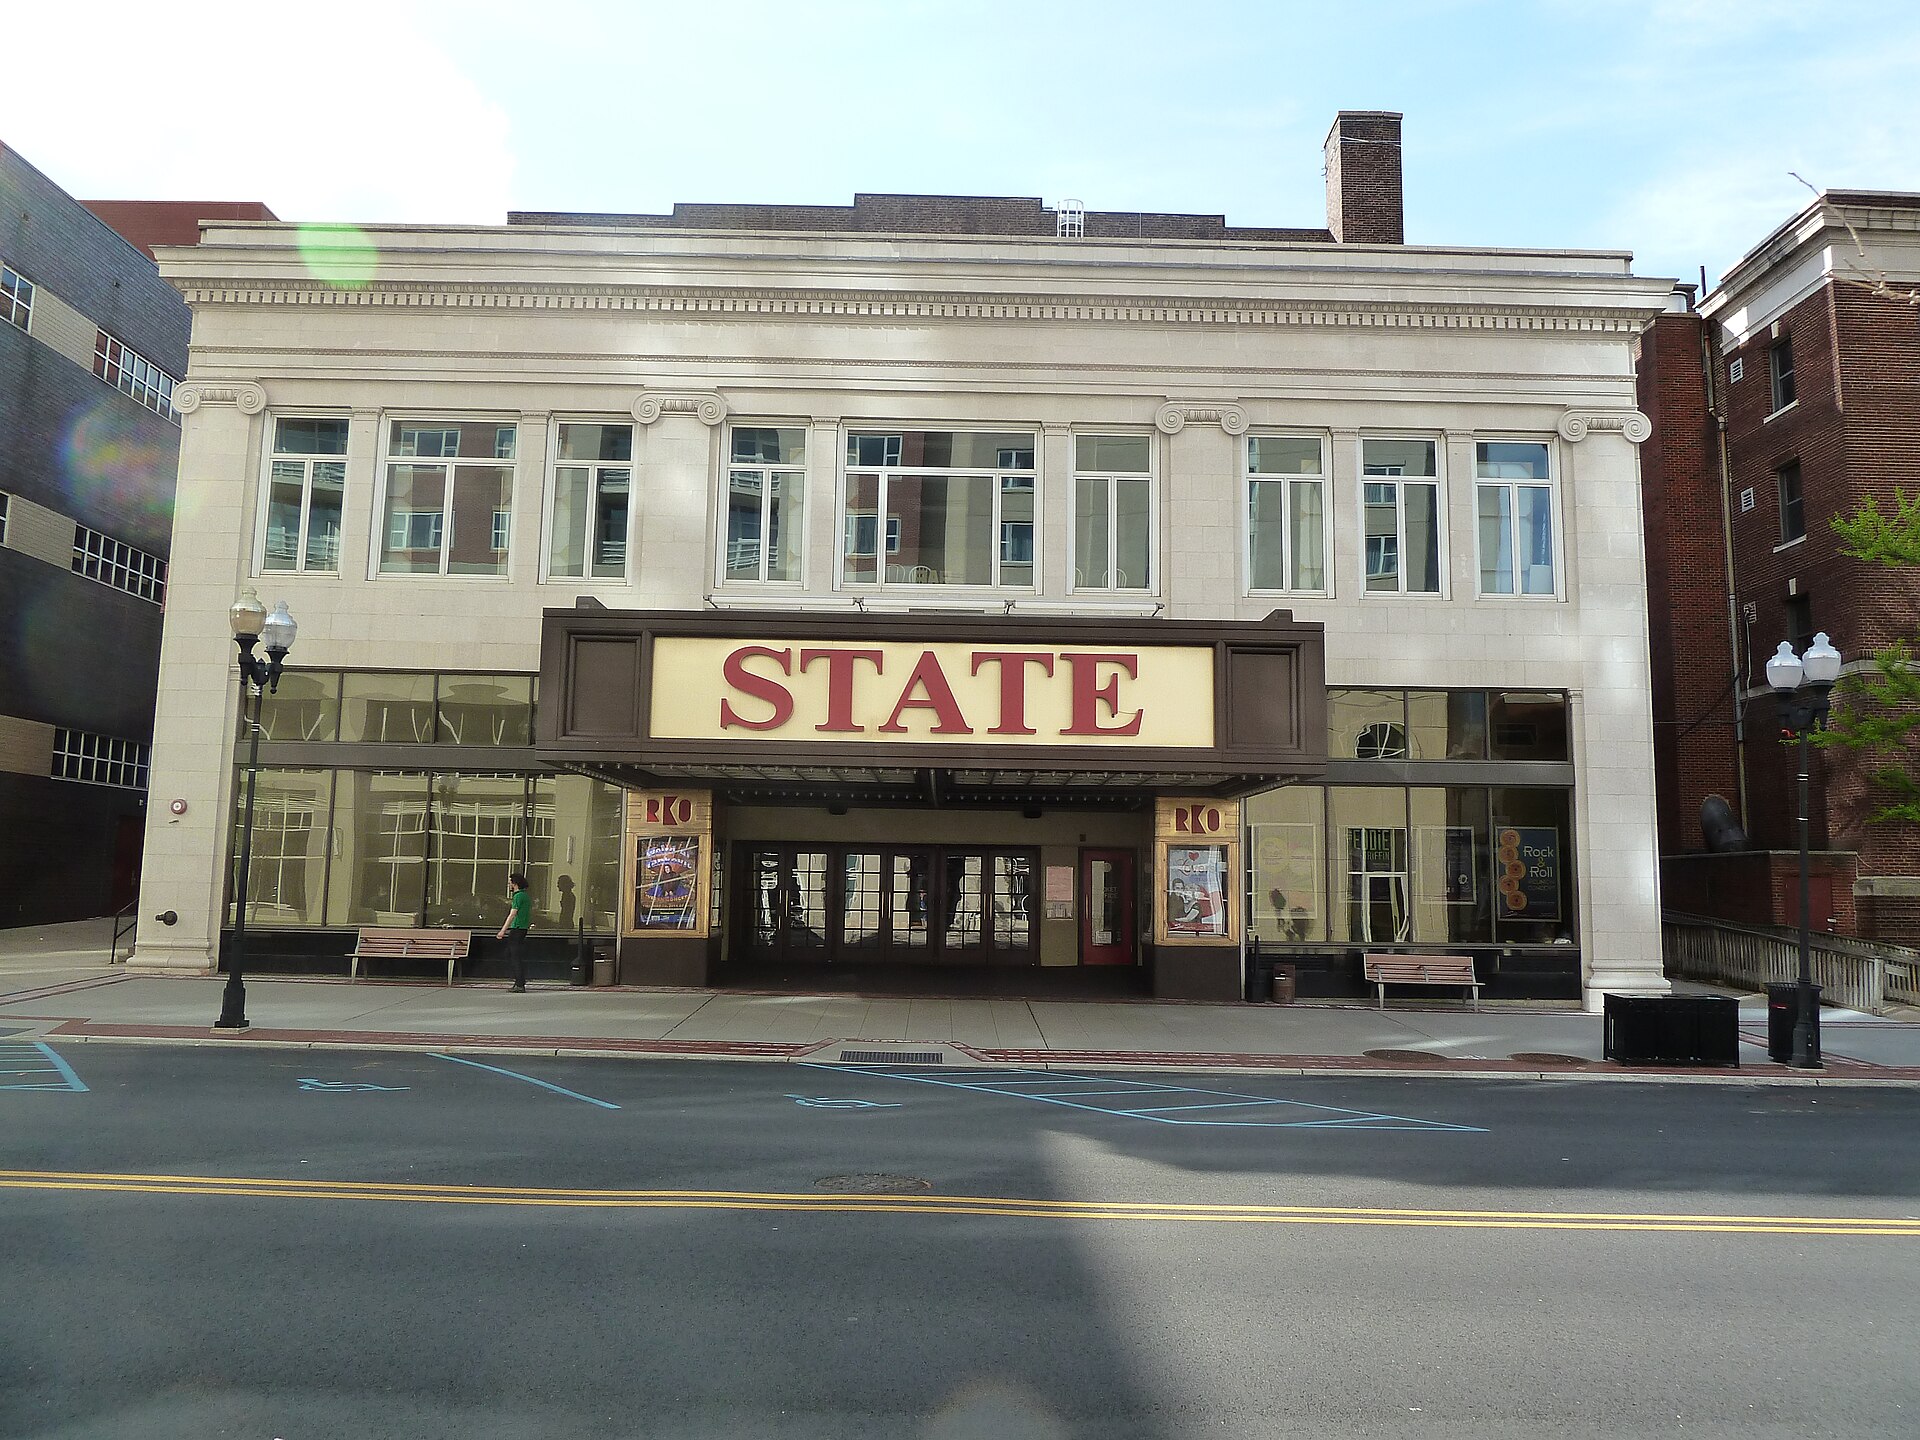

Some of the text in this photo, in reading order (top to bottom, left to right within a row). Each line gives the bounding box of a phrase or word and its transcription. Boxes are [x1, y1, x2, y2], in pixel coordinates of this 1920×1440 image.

[720, 645, 1144, 737] STATE
[646, 796, 692, 826] RKO
[1175, 804, 1221, 834] RKO
[1523, 845, 1554, 858] Rock
[1537, 857, 1546, 867] &
[1529, 866, 1553, 878] Roll
